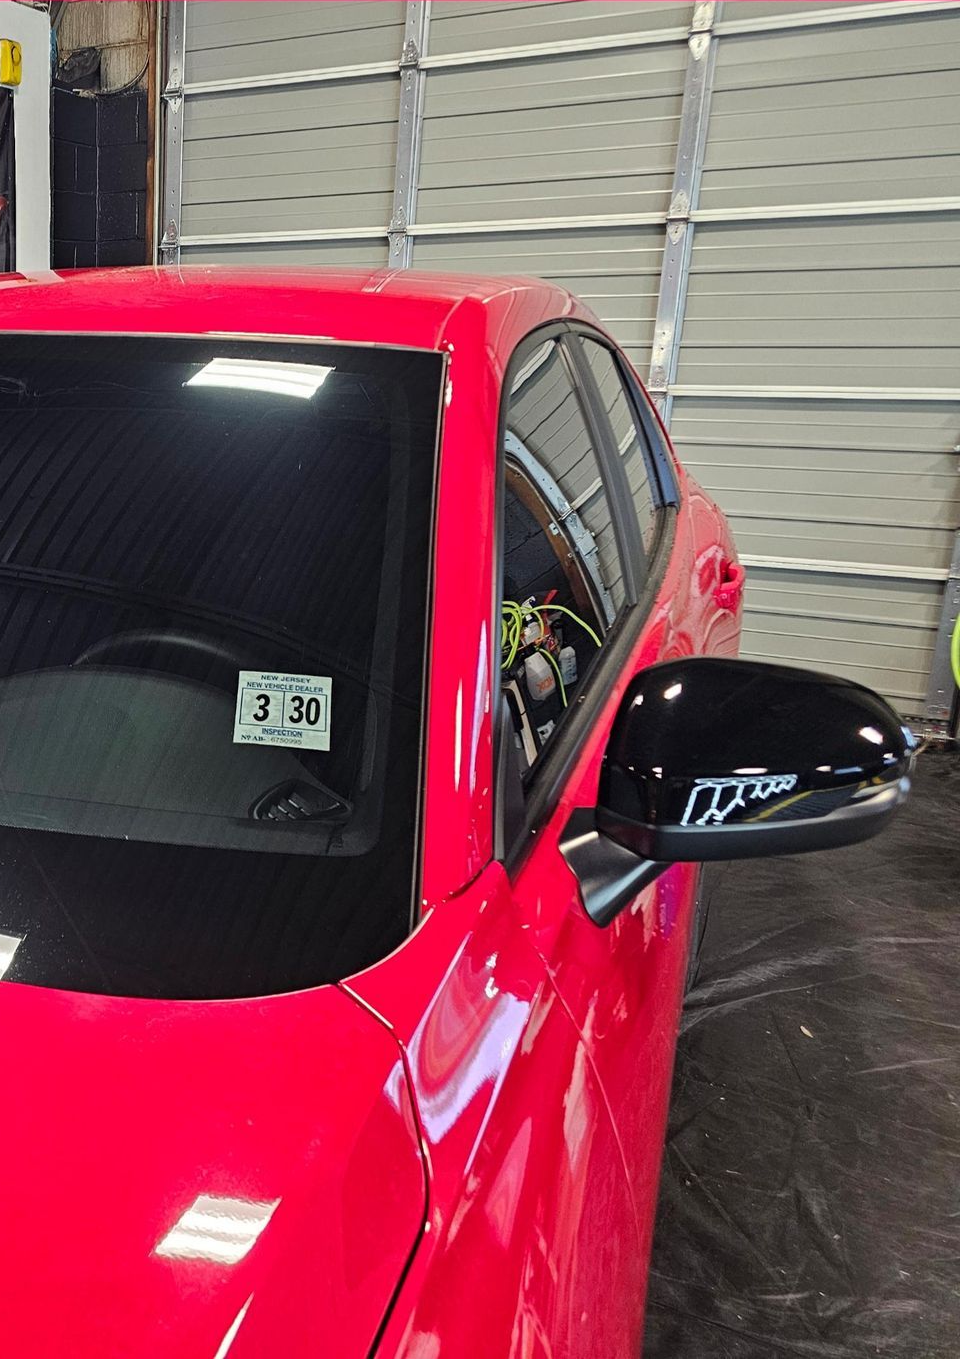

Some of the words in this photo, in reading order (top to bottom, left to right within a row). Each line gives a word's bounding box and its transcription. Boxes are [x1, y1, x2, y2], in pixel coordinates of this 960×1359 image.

[281, 676, 311, 684] JERSEY
[264, 683, 294, 691] VEHICLE
[294, 685, 324, 693] DEALER
[252, 693, 271, 722] 3
[288, 695, 321, 726] 30
[261, 727, 303, 738] INSPECTION
